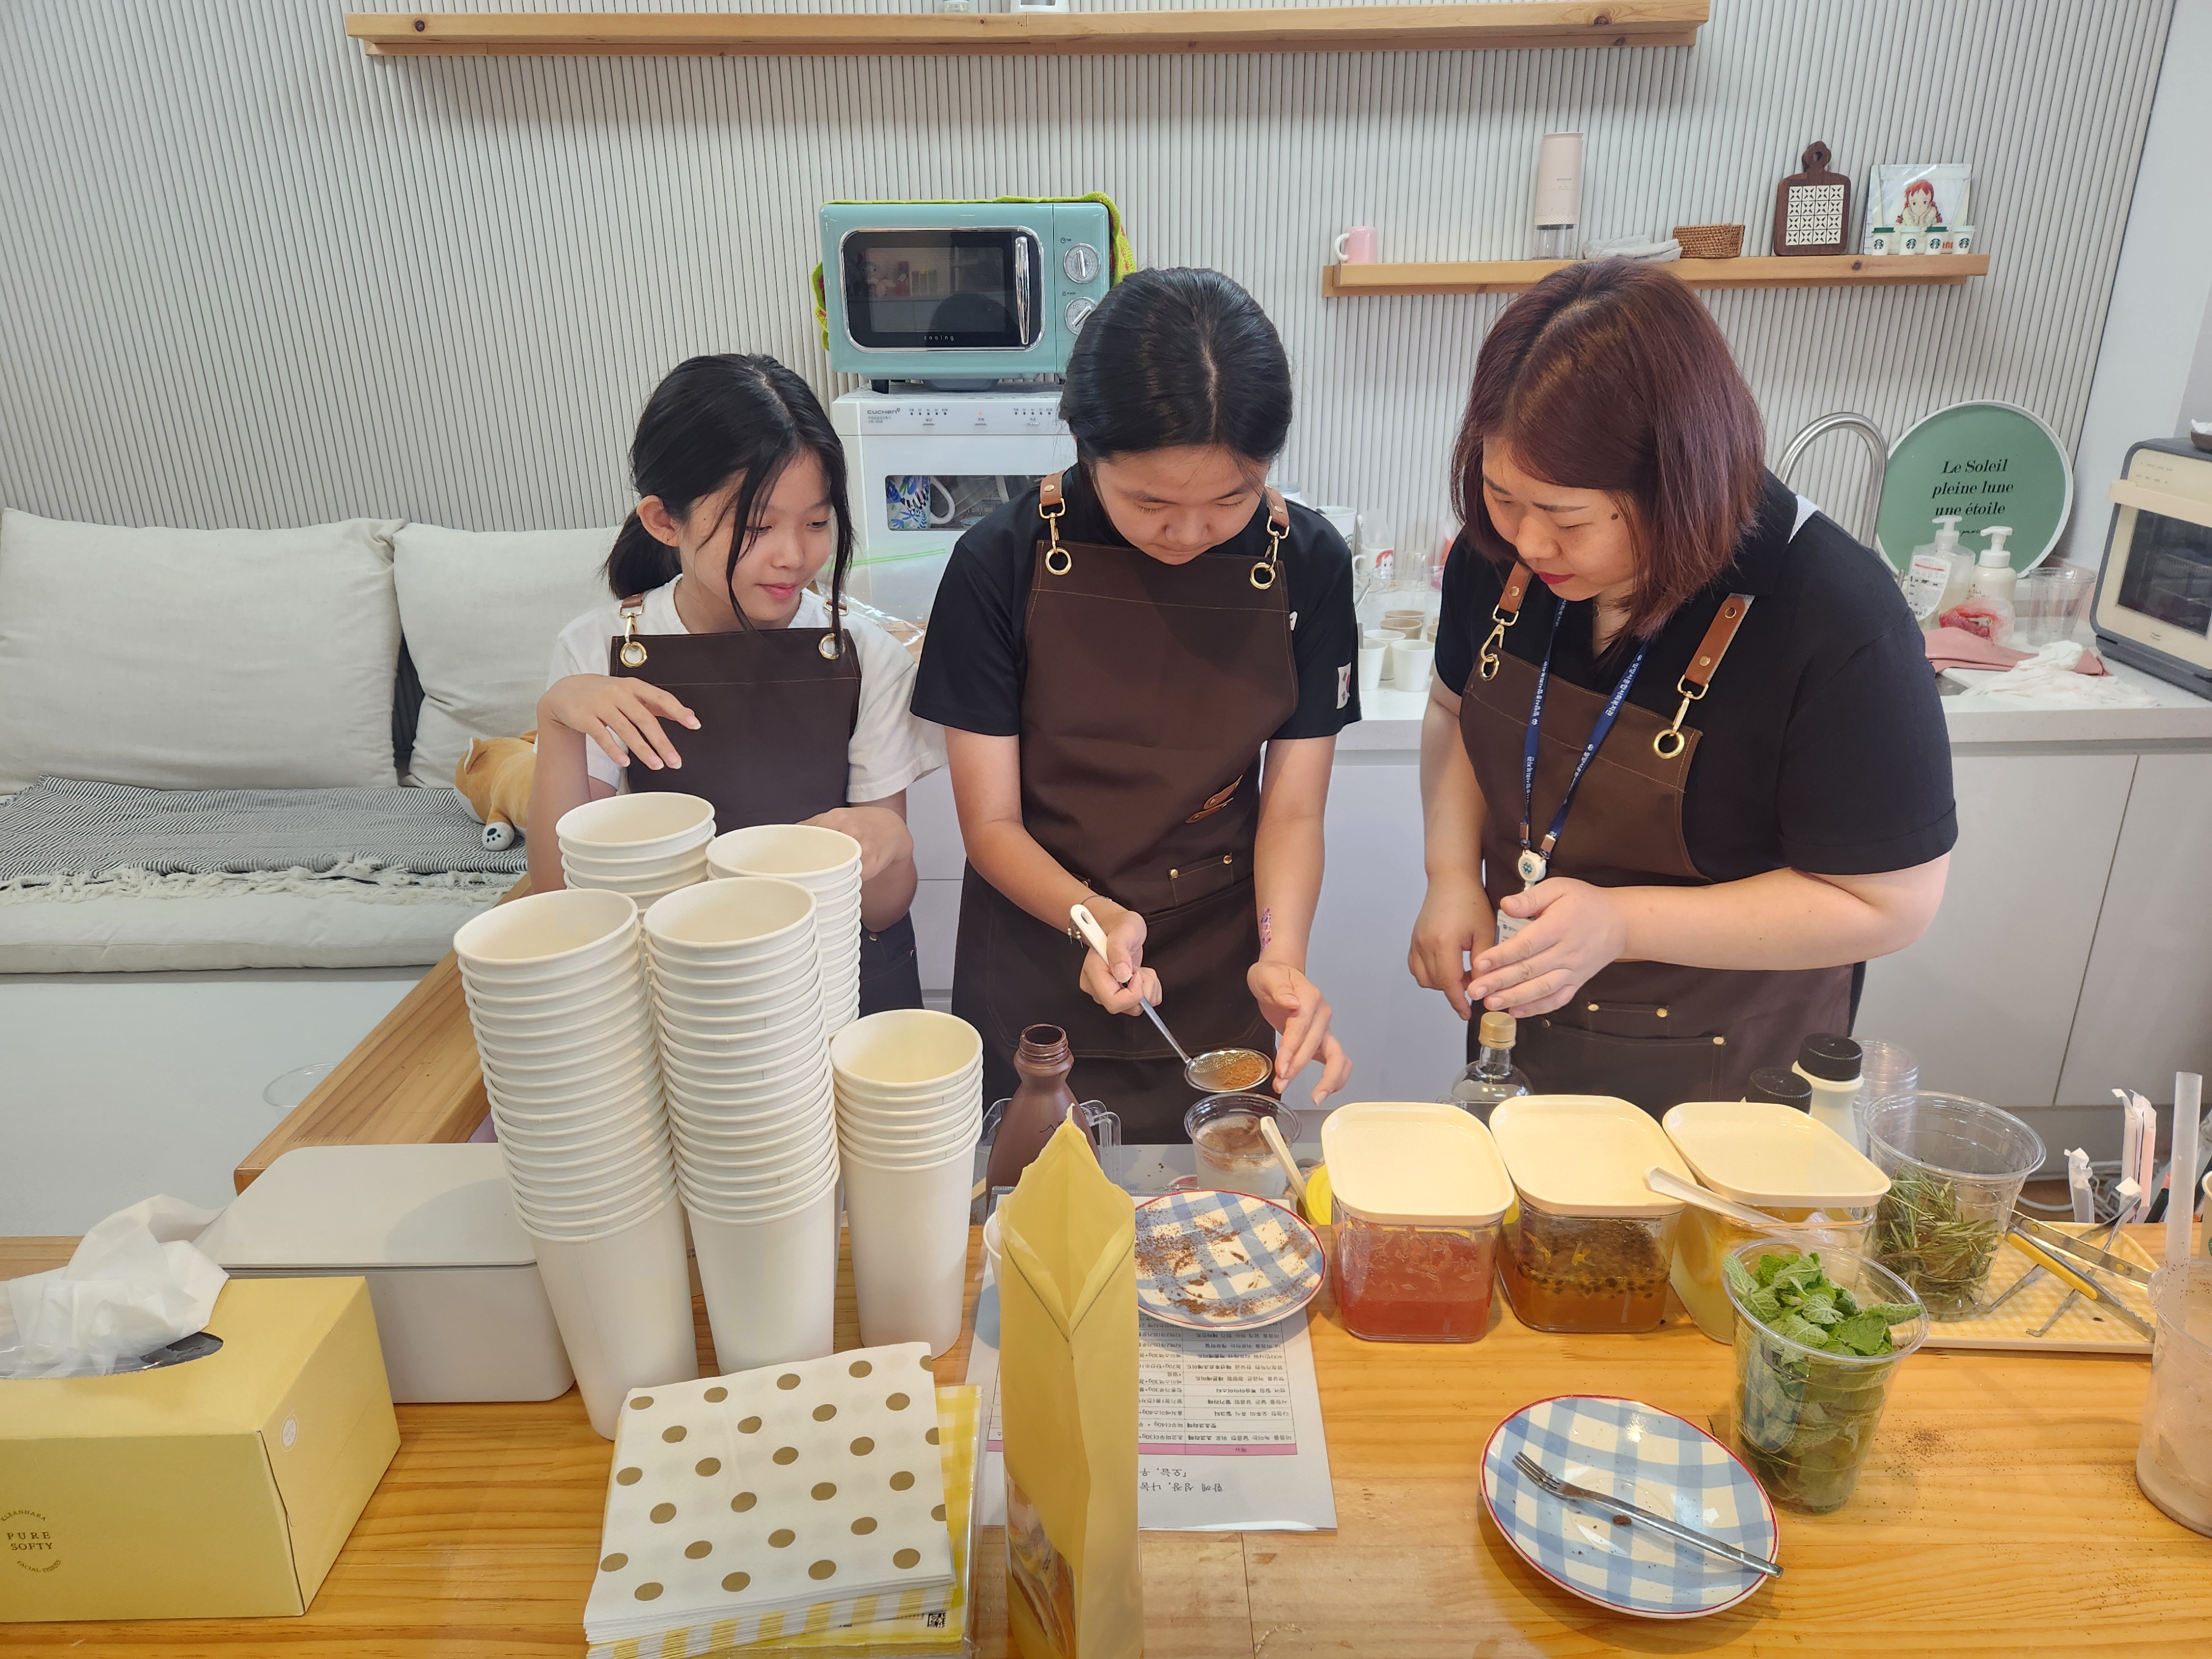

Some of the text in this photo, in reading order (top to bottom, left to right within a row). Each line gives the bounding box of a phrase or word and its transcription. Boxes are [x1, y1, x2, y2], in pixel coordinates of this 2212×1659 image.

[1940, 458, 2008, 474] Le Soleil
[1931, 481, 2013, 498] pleine lune
[1936, 502, 2005, 516] une étoile
[1168, 1482, 1194, 1492] 성장,
[1202, 1483, 1223, 1492] 함께
[11, 1542, 53, 1551] SOFTY
